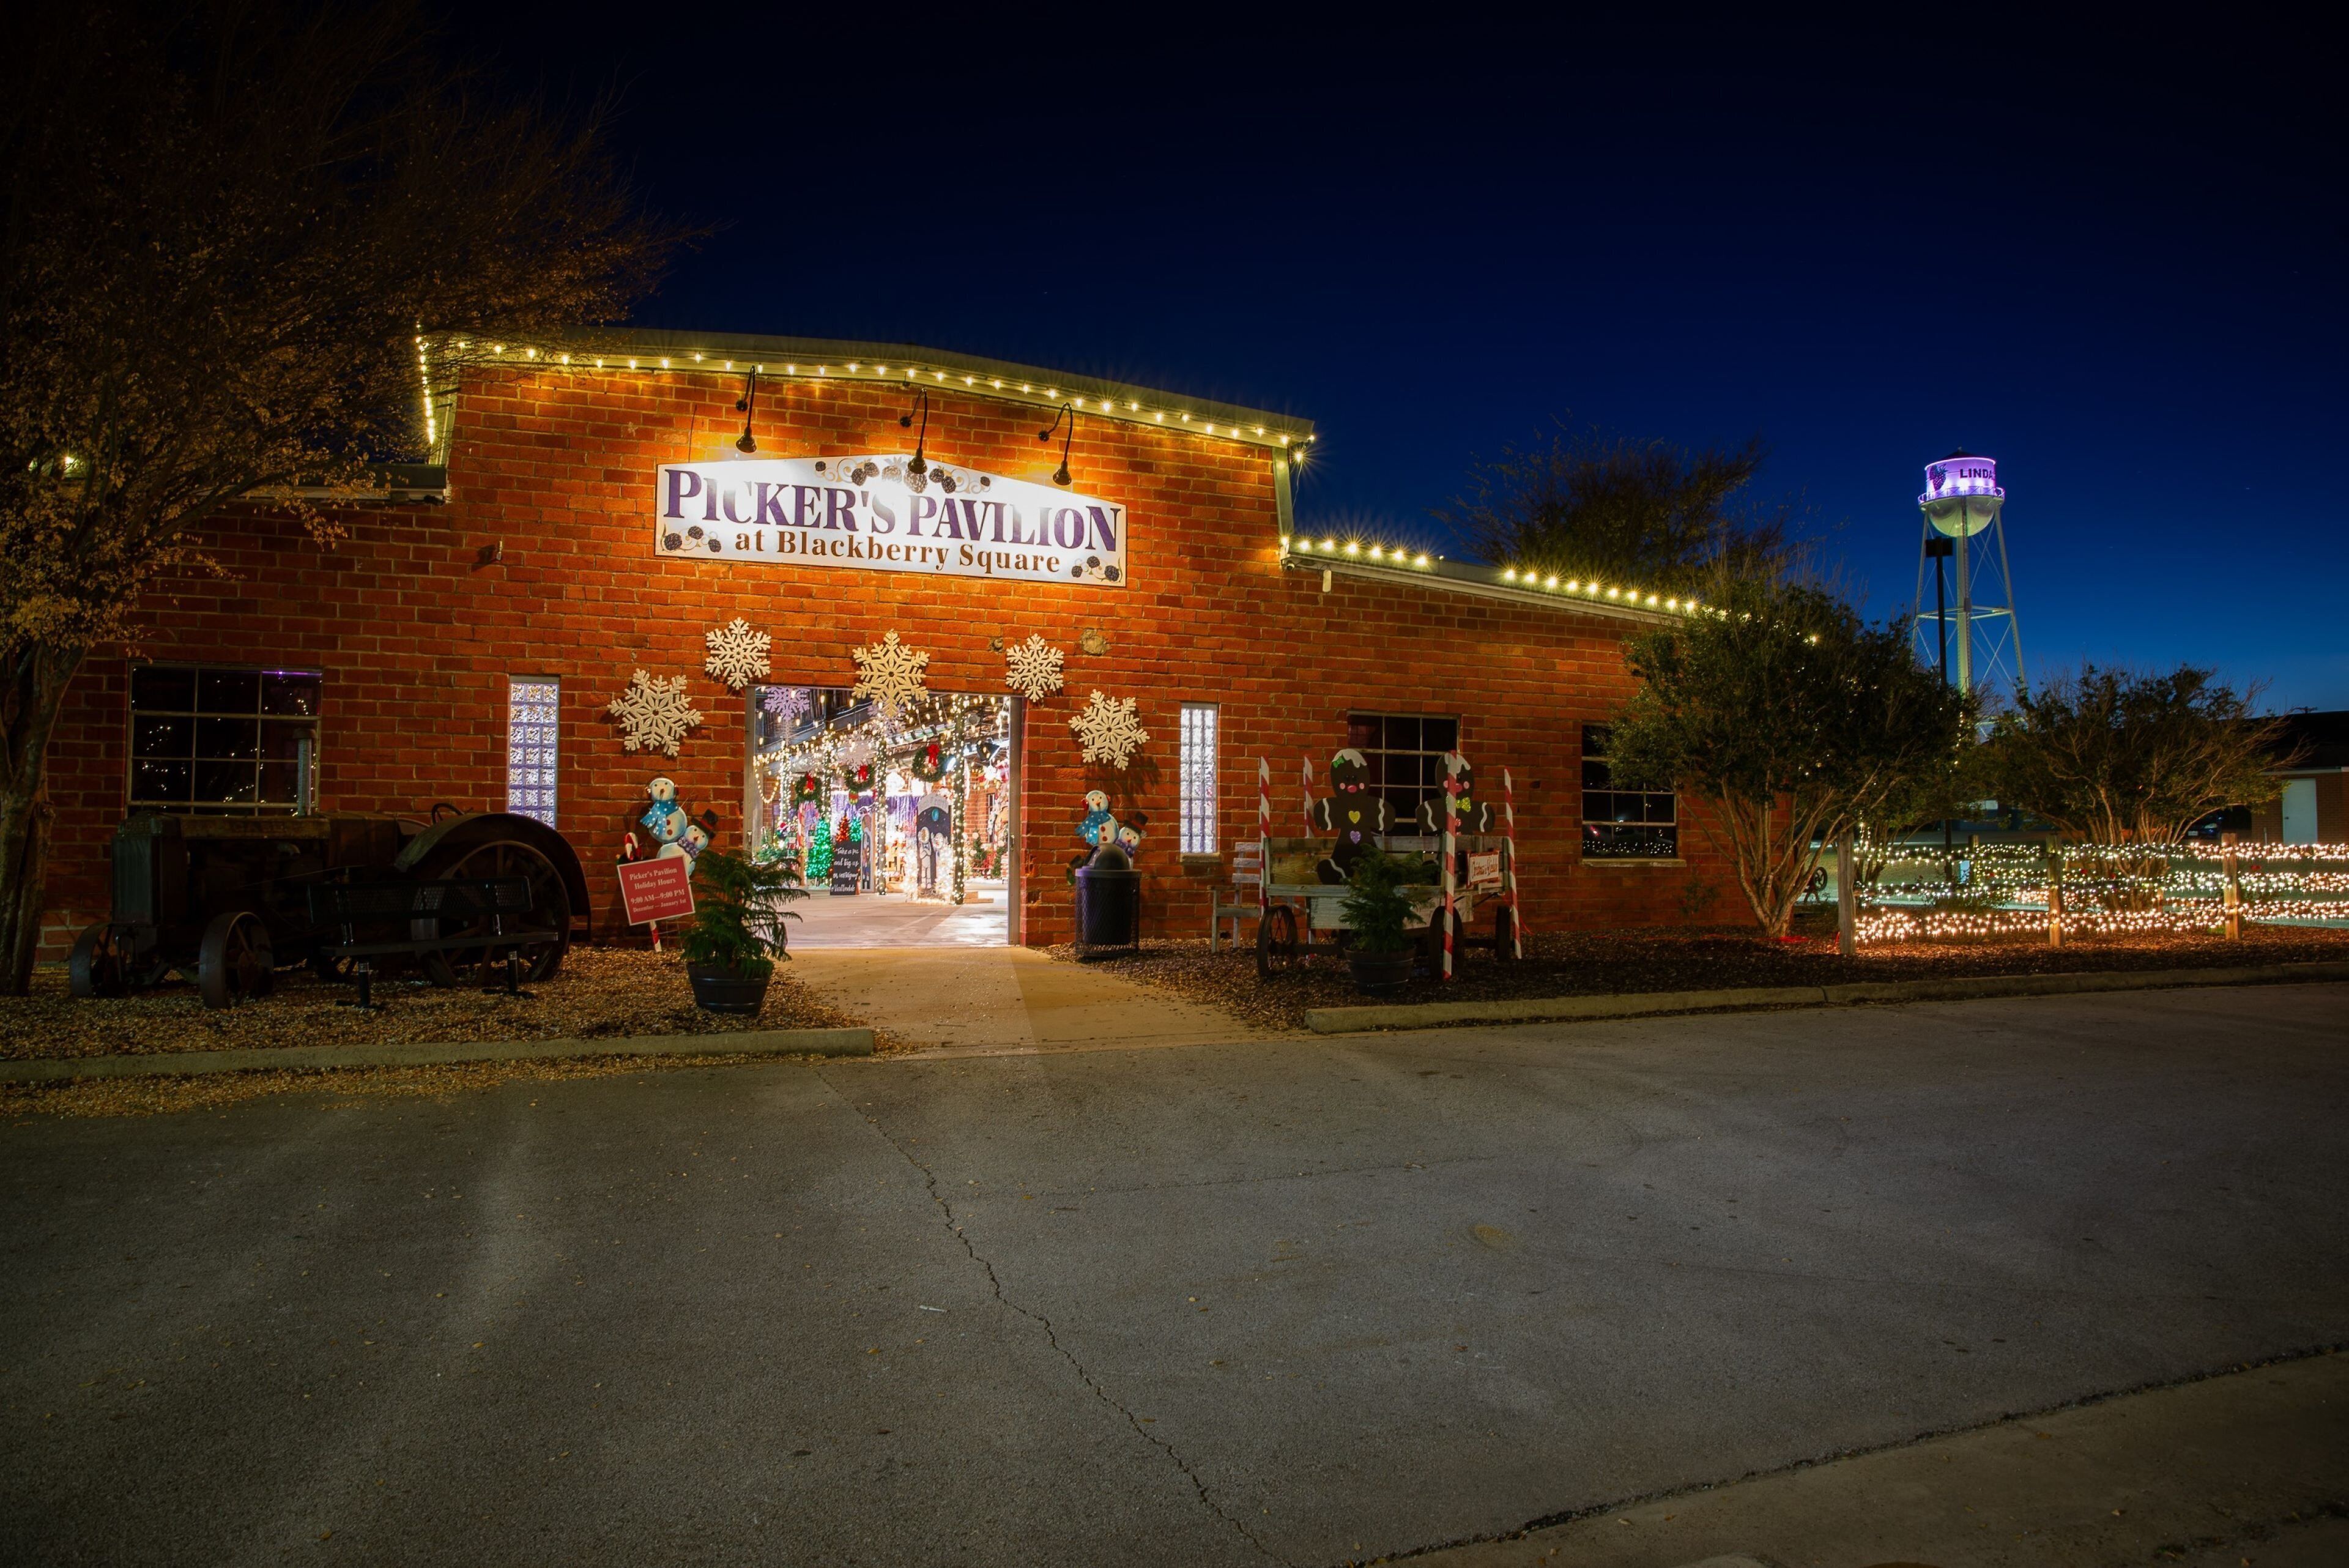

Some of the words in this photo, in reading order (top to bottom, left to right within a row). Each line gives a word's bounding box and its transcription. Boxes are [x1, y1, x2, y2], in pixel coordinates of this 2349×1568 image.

[663, 469, 896, 534] PICKER'S
[907, 494, 1121, 552] PAVILION
[735, 529, 765, 552] at
[776, 530, 949, 571] Blackberry
[959, 544, 1061, 574] Square
[629, 871, 653, 880] Picker's
[654, 868, 677, 876] Pavilion
[634, 880, 656, 890] Holiday
